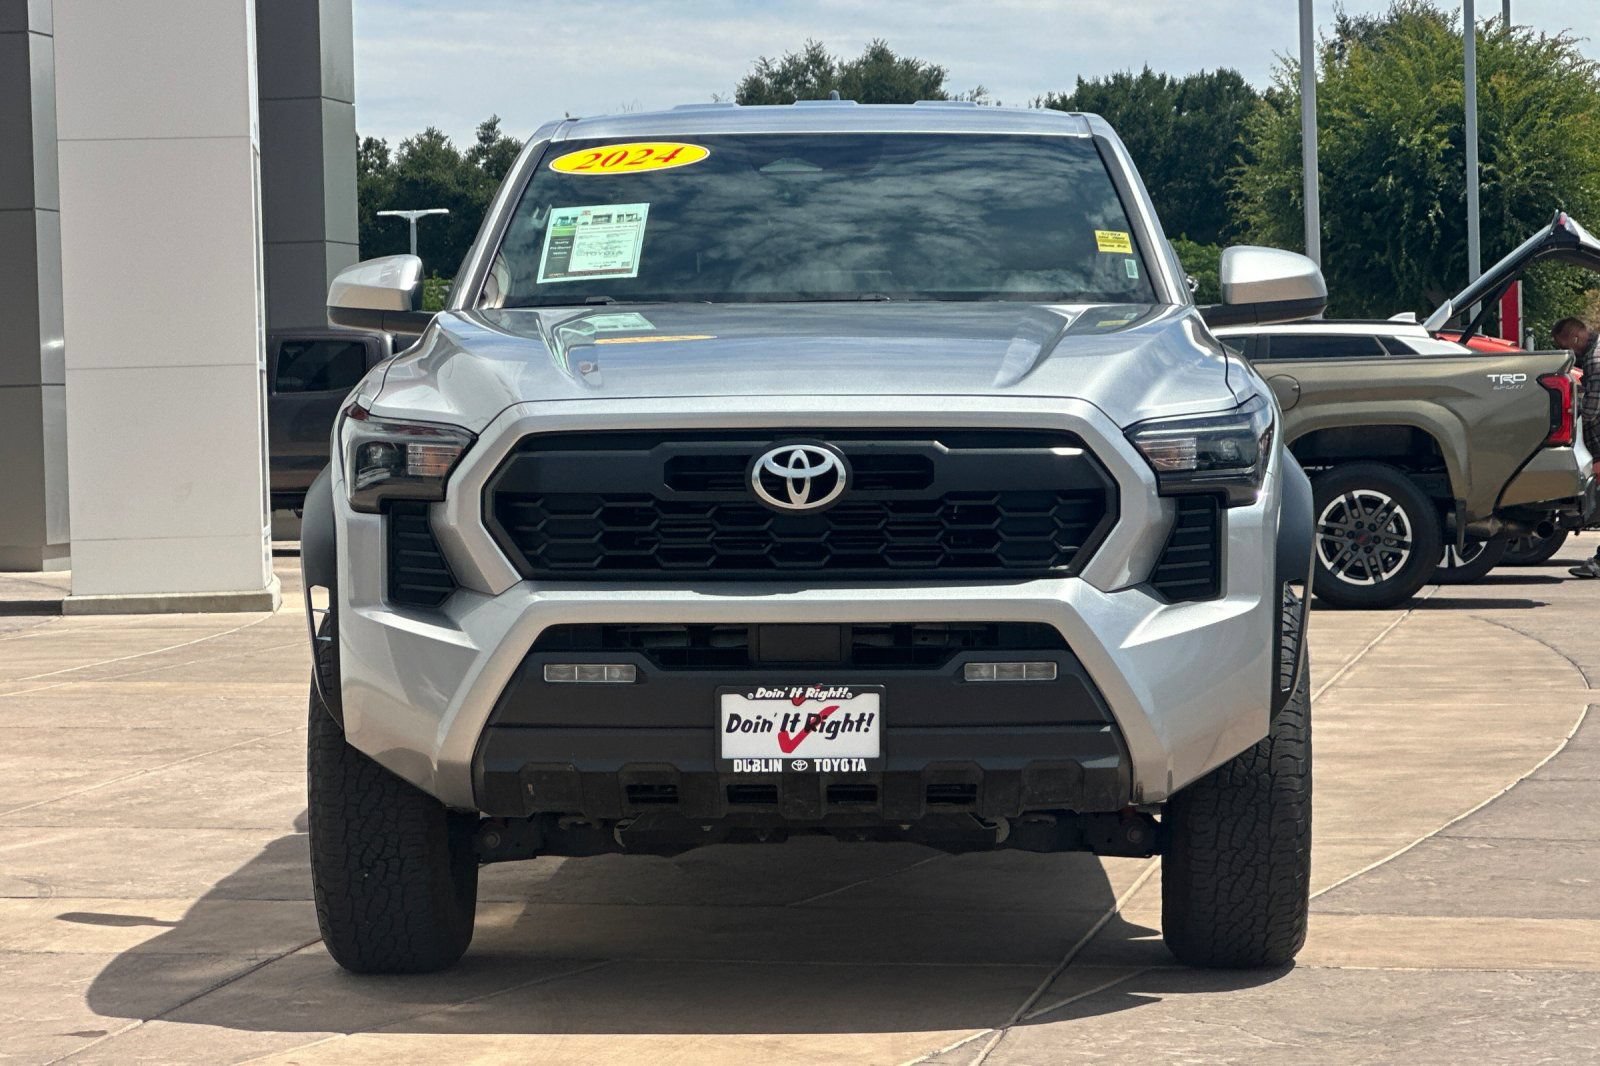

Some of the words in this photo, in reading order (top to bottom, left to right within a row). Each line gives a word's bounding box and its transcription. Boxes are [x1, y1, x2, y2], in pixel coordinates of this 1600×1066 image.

[572, 147, 685, 170] 2024
[755, 687, 788, 699] Doin'
[789, 687, 804, 699] It
[804, 687, 849, 701] Right!
[725, 713, 778, 734] Doin'
[779, 713, 803, 733] It
[803, 713, 875, 740] Right!
[733, 758, 783, 773] DUBLIN
[813, 758, 867, 773] TOYOTA
